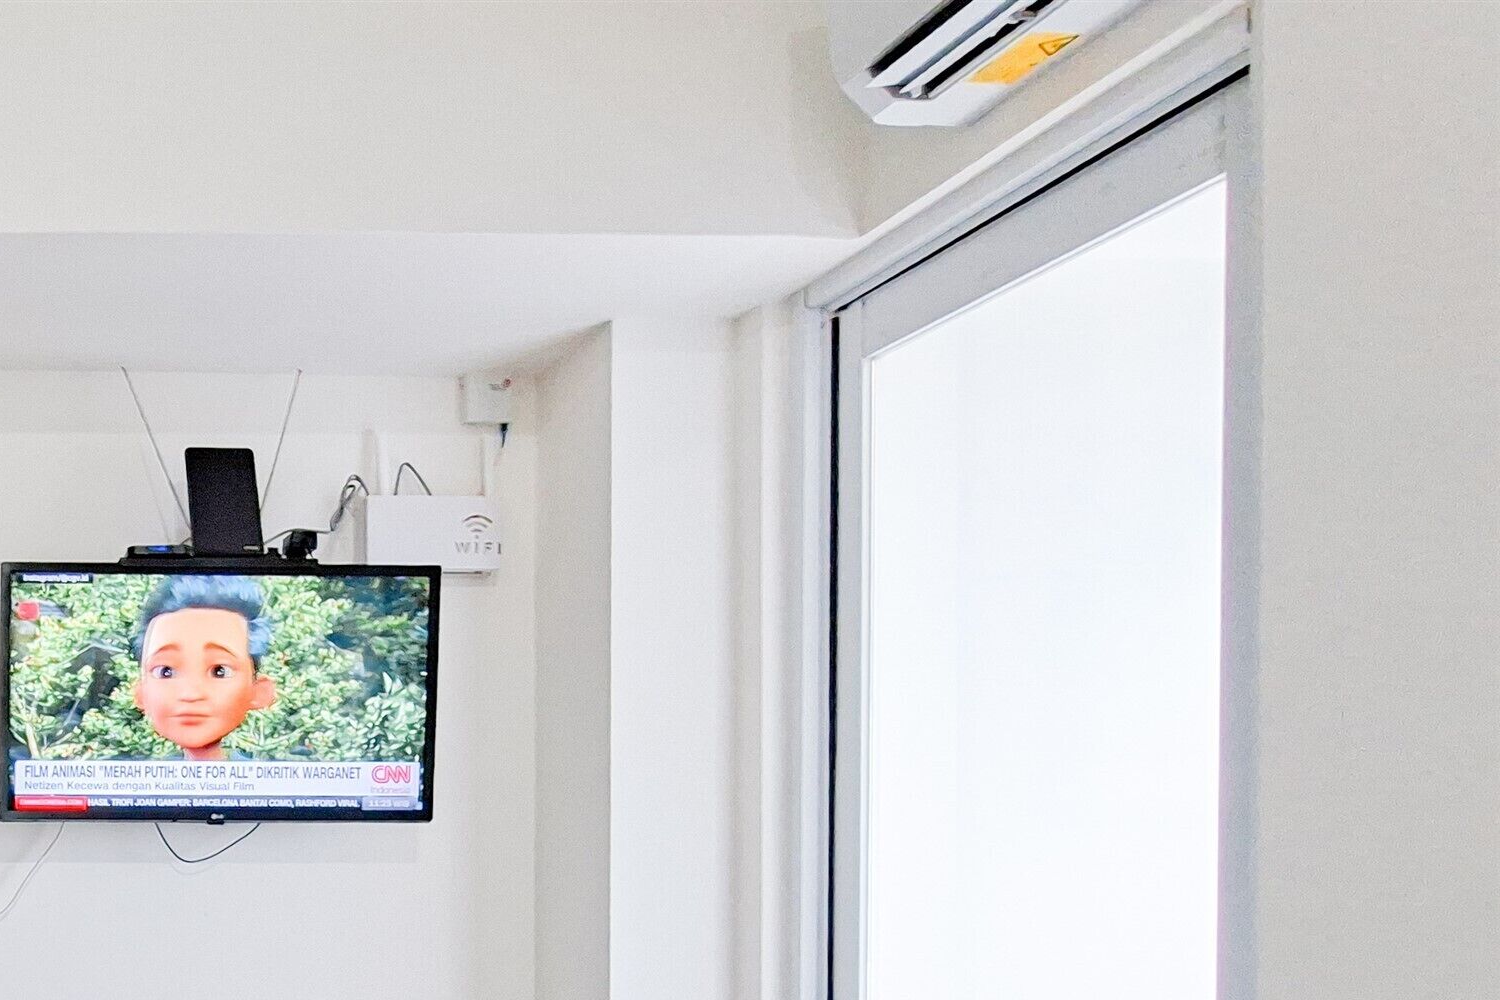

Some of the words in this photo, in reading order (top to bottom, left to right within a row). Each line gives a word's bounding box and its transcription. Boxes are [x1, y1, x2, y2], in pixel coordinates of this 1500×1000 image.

[24, 765, 49, 778] FILM
[51, 765, 96, 778] ANIMASI
[144, 765, 178, 778] PUTIH:
[180, 766, 202, 778] ONE
[205, 766, 226, 778] FOR
[256, 766, 300, 779] DIKRITIK
[302, 766, 362, 779] WARGANET
[371, 765, 411, 784] CNN
[24, 781, 64, 790] Netizen
[67, 781, 109, 790] Kecewa
[112, 781, 152, 792] dengan
[154, 781, 197, 791] Kualitas
[199, 782, 230, 791] Visual
[233, 782, 255, 791] Film
[192, 798, 238, 807] BARCELONA
